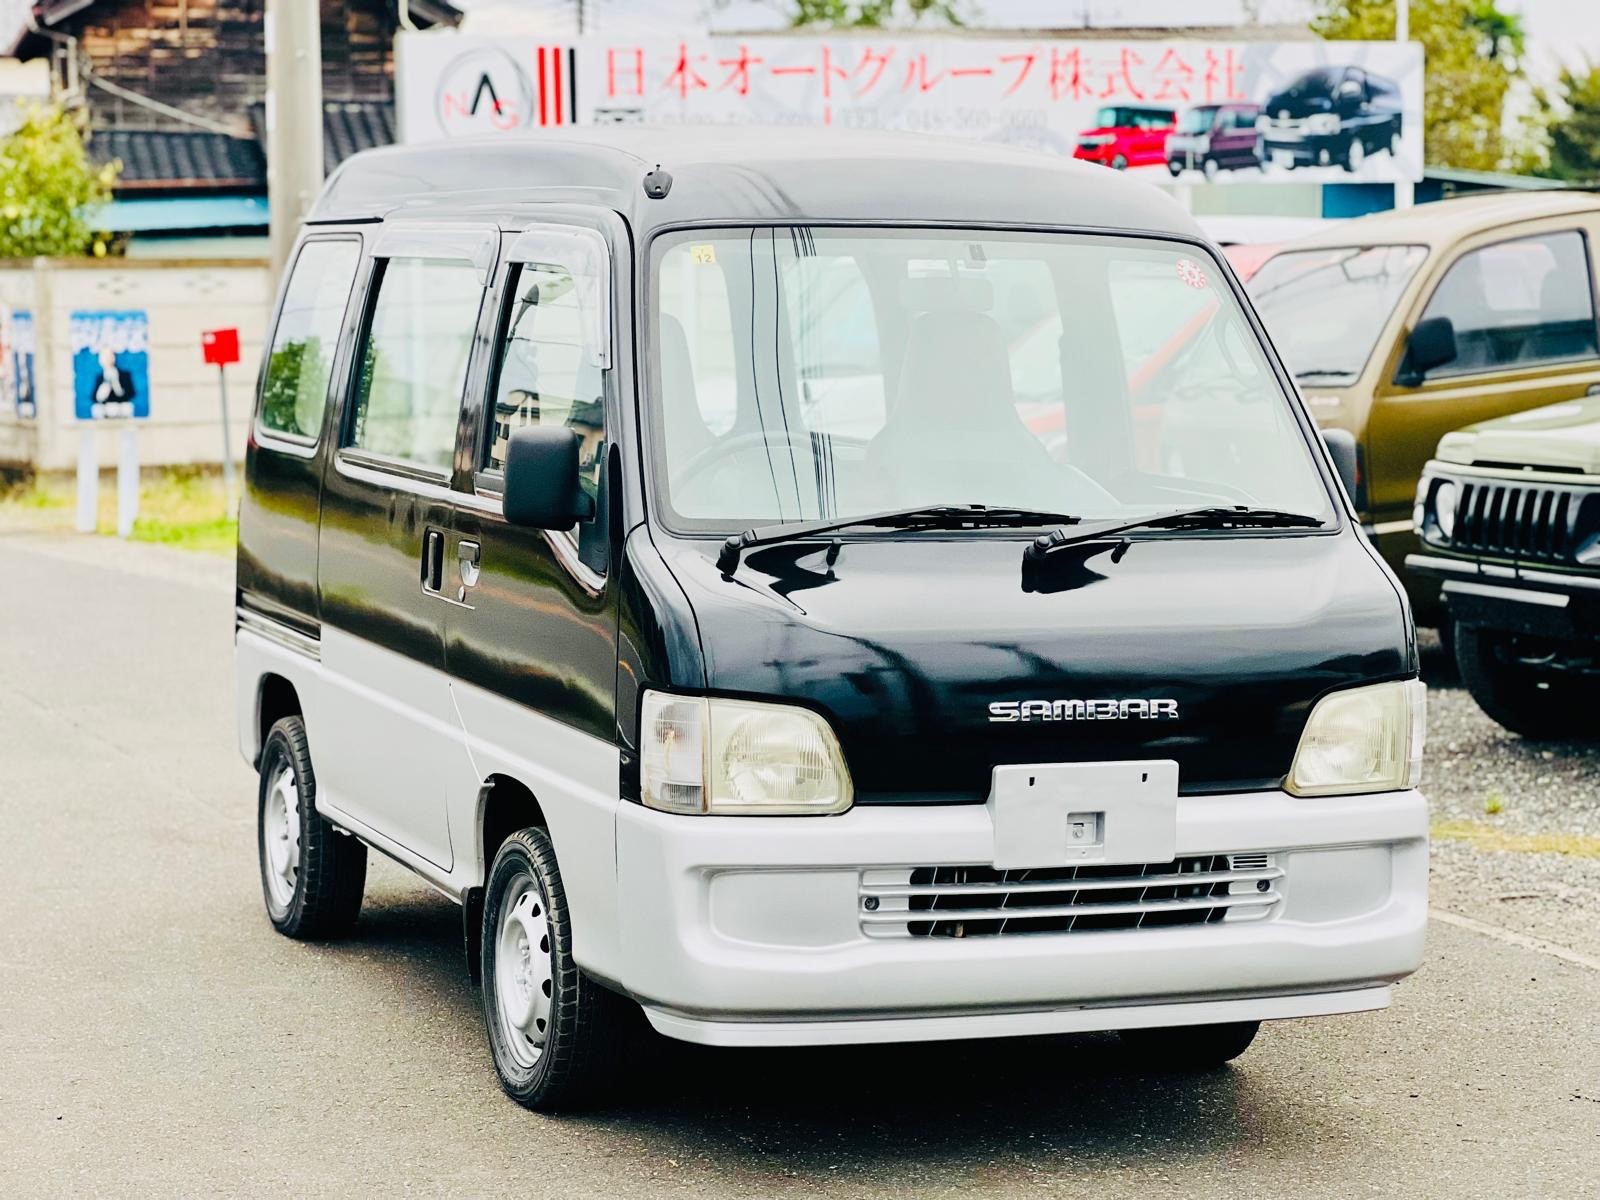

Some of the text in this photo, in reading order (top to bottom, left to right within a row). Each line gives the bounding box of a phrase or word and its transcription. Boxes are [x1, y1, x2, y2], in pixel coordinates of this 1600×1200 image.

[604, 44, 1246, 102] 日本オートグループ株式会社
[988, 699, 1179, 722] SAMBAR
